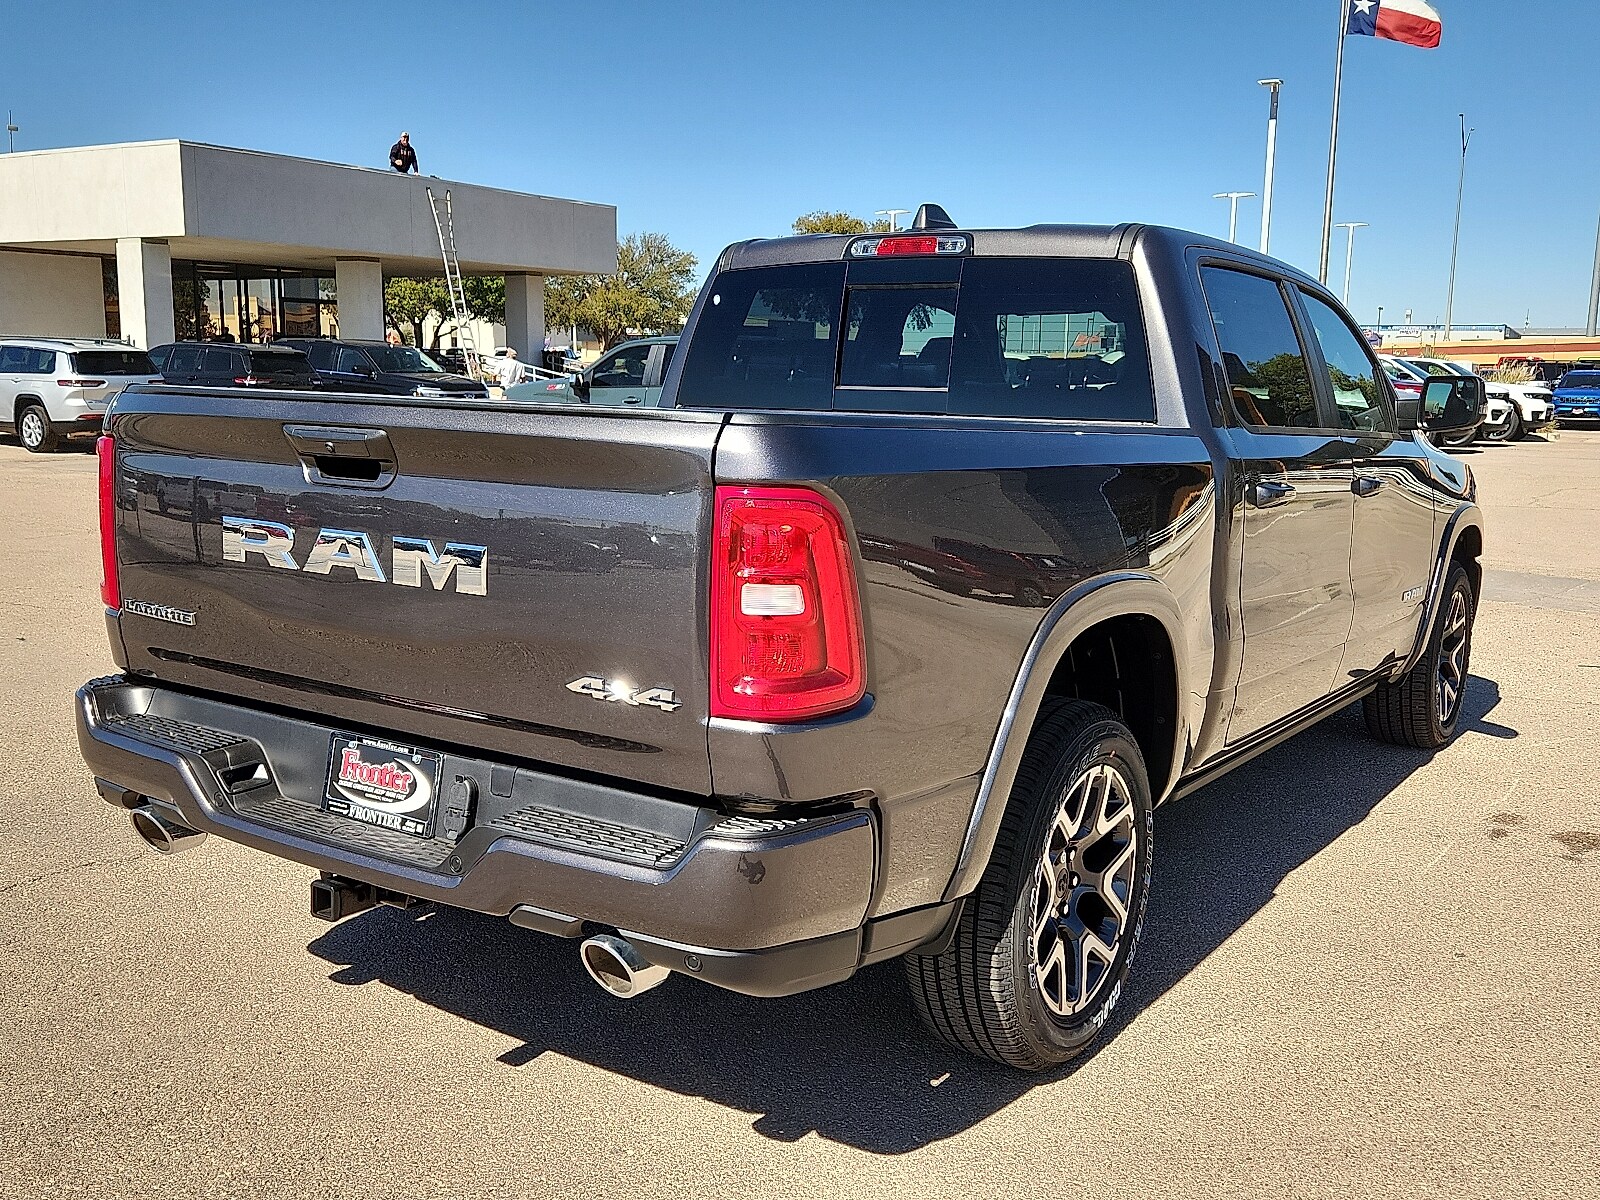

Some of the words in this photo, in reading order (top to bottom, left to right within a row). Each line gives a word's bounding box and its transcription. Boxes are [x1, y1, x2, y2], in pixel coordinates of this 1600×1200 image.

[222, 515, 488, 596] RAM
[123, 598, 197, 626] LARAMIE
[340, 749, 412, 792] Frontier
[349, 804, 402, 831] FRONTIER
